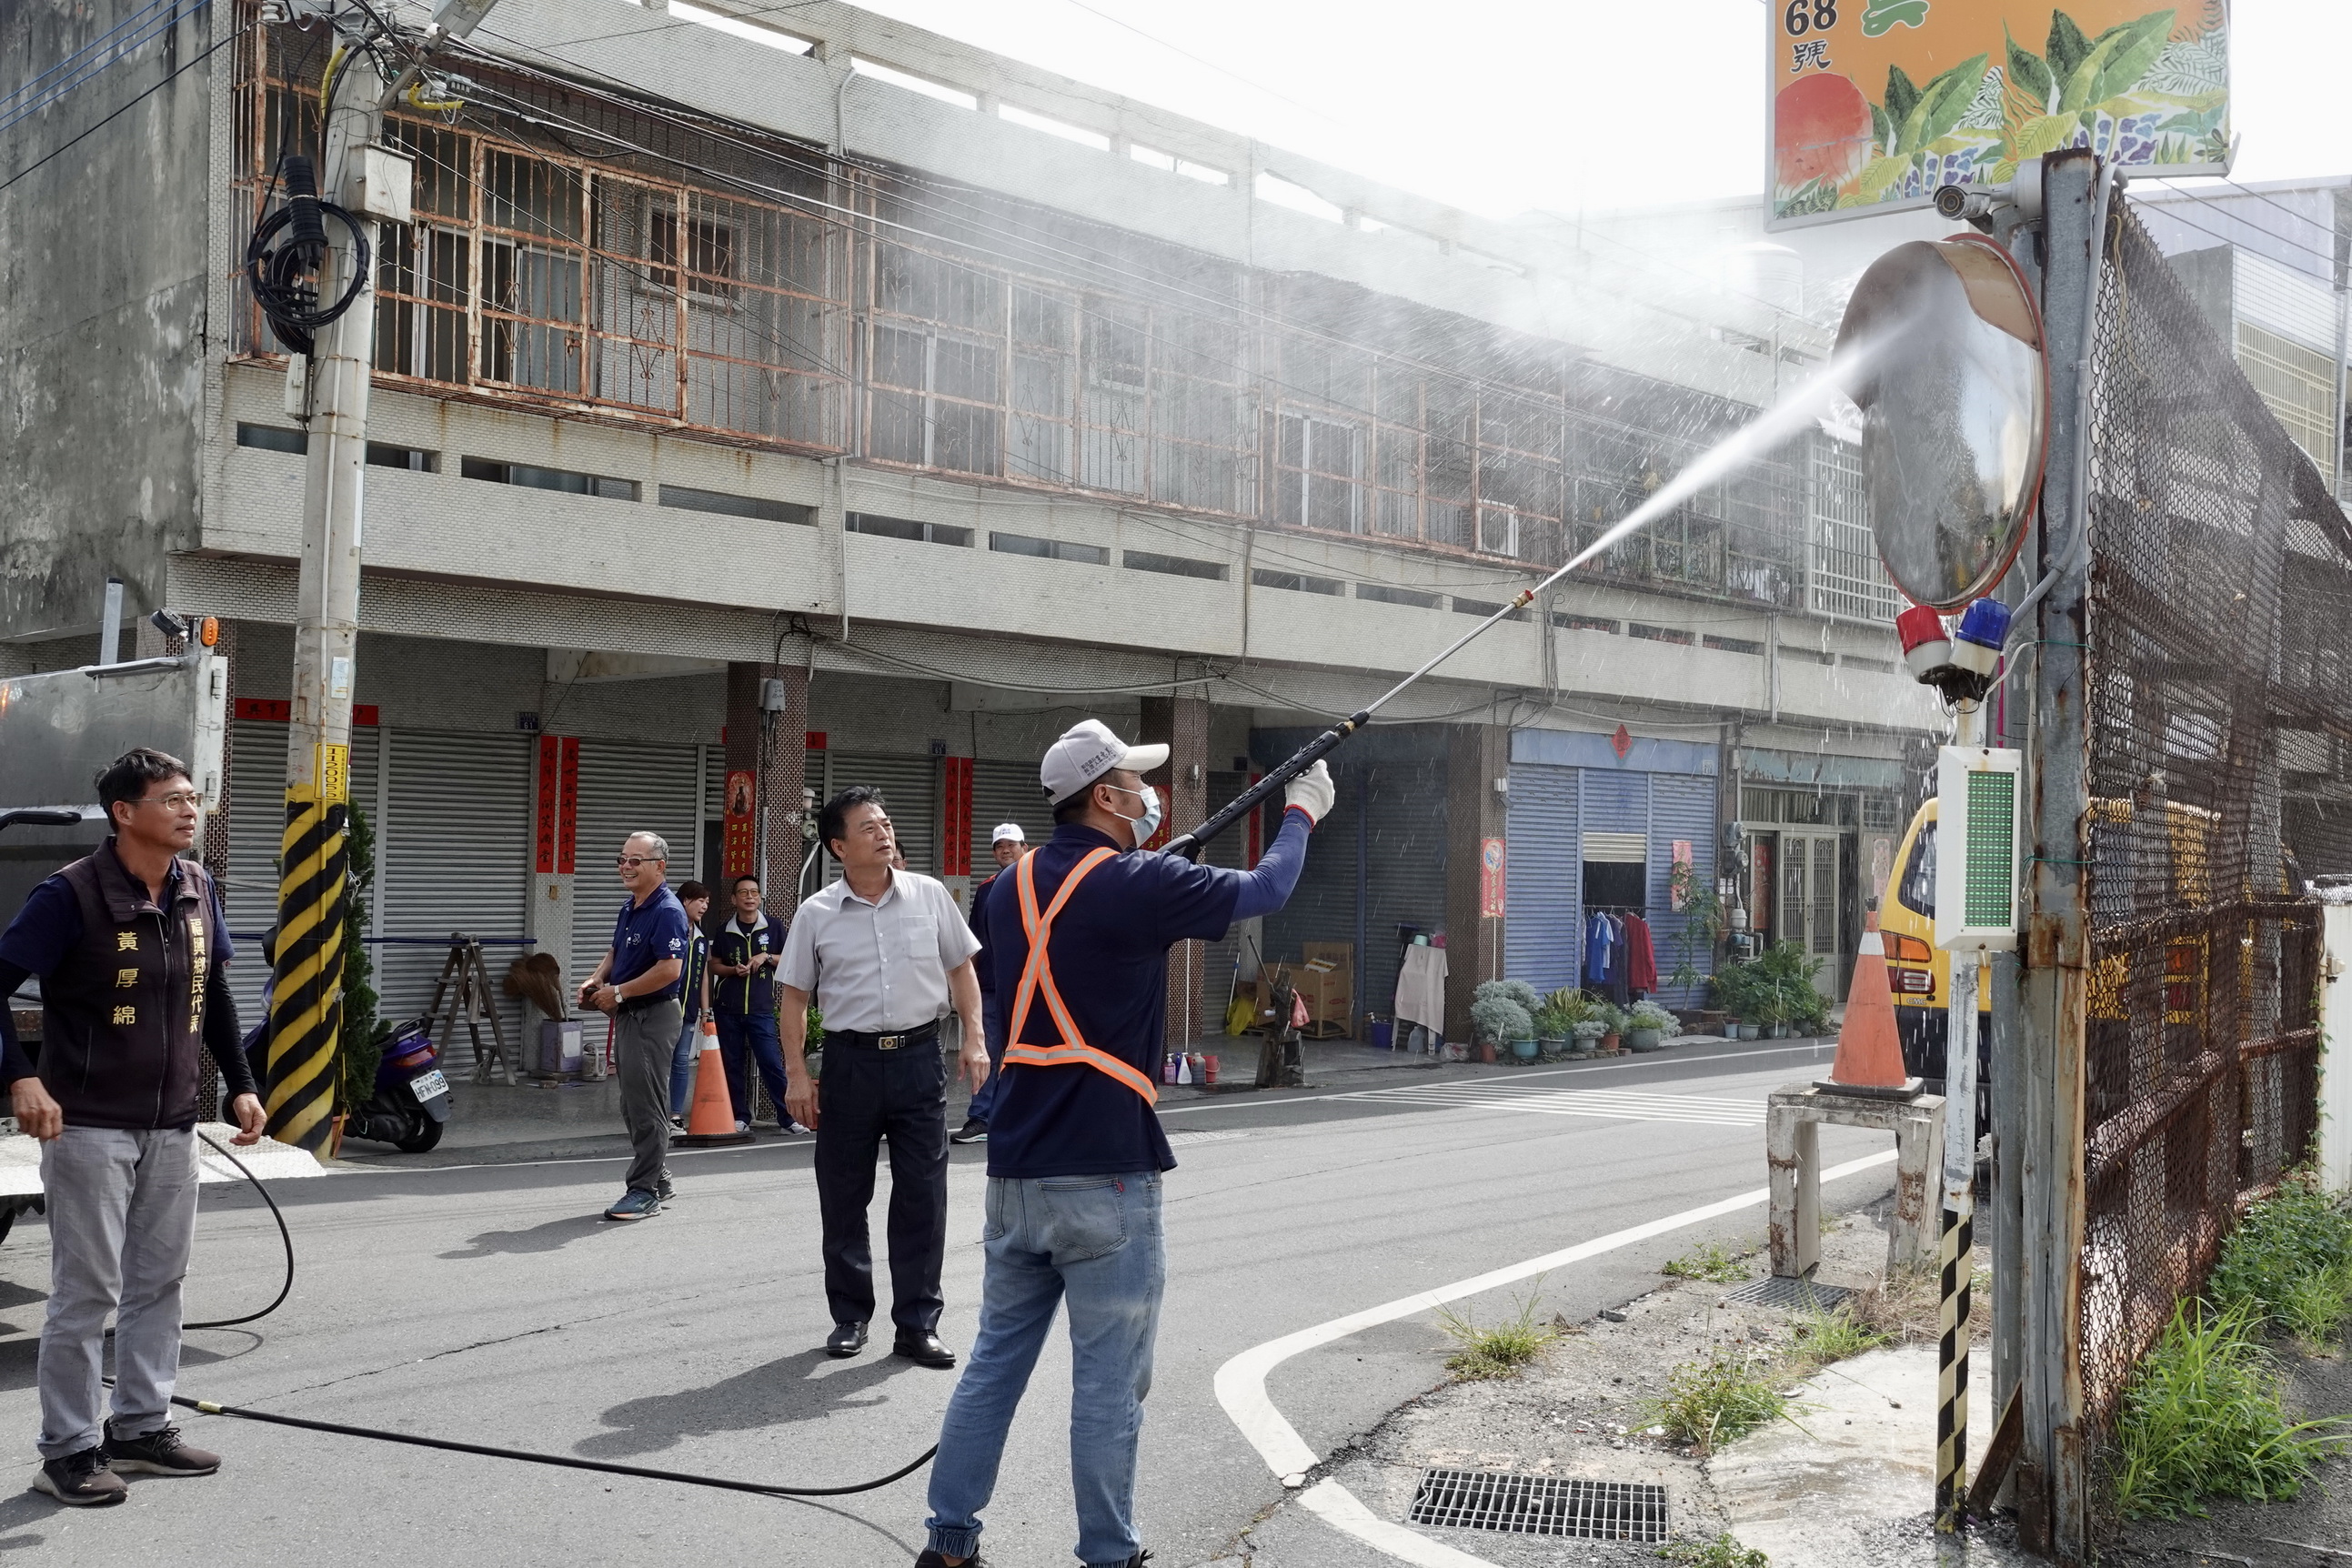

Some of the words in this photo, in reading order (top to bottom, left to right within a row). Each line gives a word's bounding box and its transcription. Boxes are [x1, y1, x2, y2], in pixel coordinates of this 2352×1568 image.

[1786, 0, 1837, 35] 68
[1791, 40, 1831, 72] 號
[114, 930, 139, 1026] 黃厚綿
[188, 918, 206, 1033] 福興鄉民代表
[1906, 997, 1926, 1005] CMC
[415, 1077, 447, 1100] HFN-099
